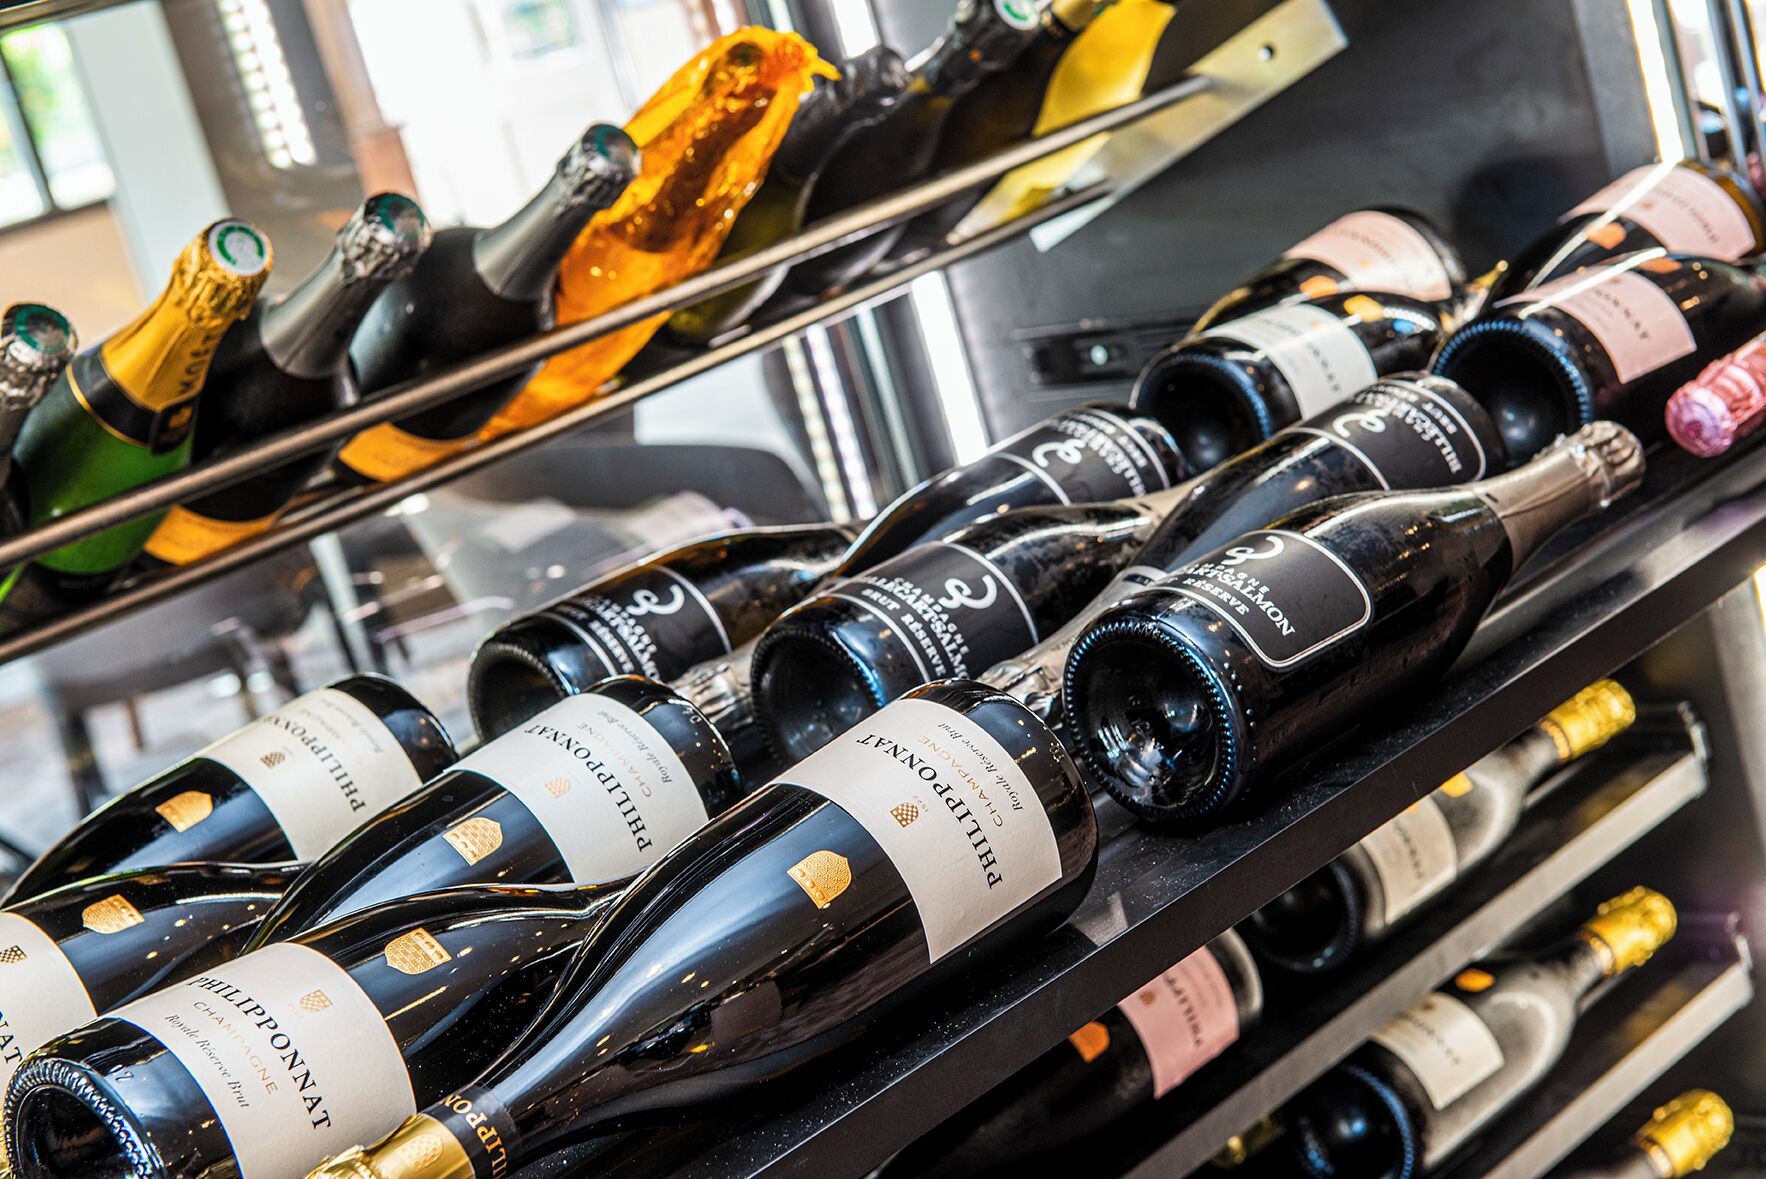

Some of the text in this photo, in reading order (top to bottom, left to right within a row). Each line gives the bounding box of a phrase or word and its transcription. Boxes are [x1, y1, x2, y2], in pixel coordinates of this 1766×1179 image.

[861, 587, 947, 677] BRUT RÉSERVE
[524, 724, 653, 852] PHILIPPONNAT
[645, 751, 673, 783] Royale
[856, 733, 1003, 889] PHILIPPONNAT
[916, 735, 1004, 828] CHAMPAGNE
[937, 722, 1024, 811] Royale Réserve Brut
[164, 1013, 250, 1108] Royale Réserve Brut
[187, 977, 332, 1130] PHILIPPONNAT
[192, 1001, 279, 1095] CHAMPAGNE
